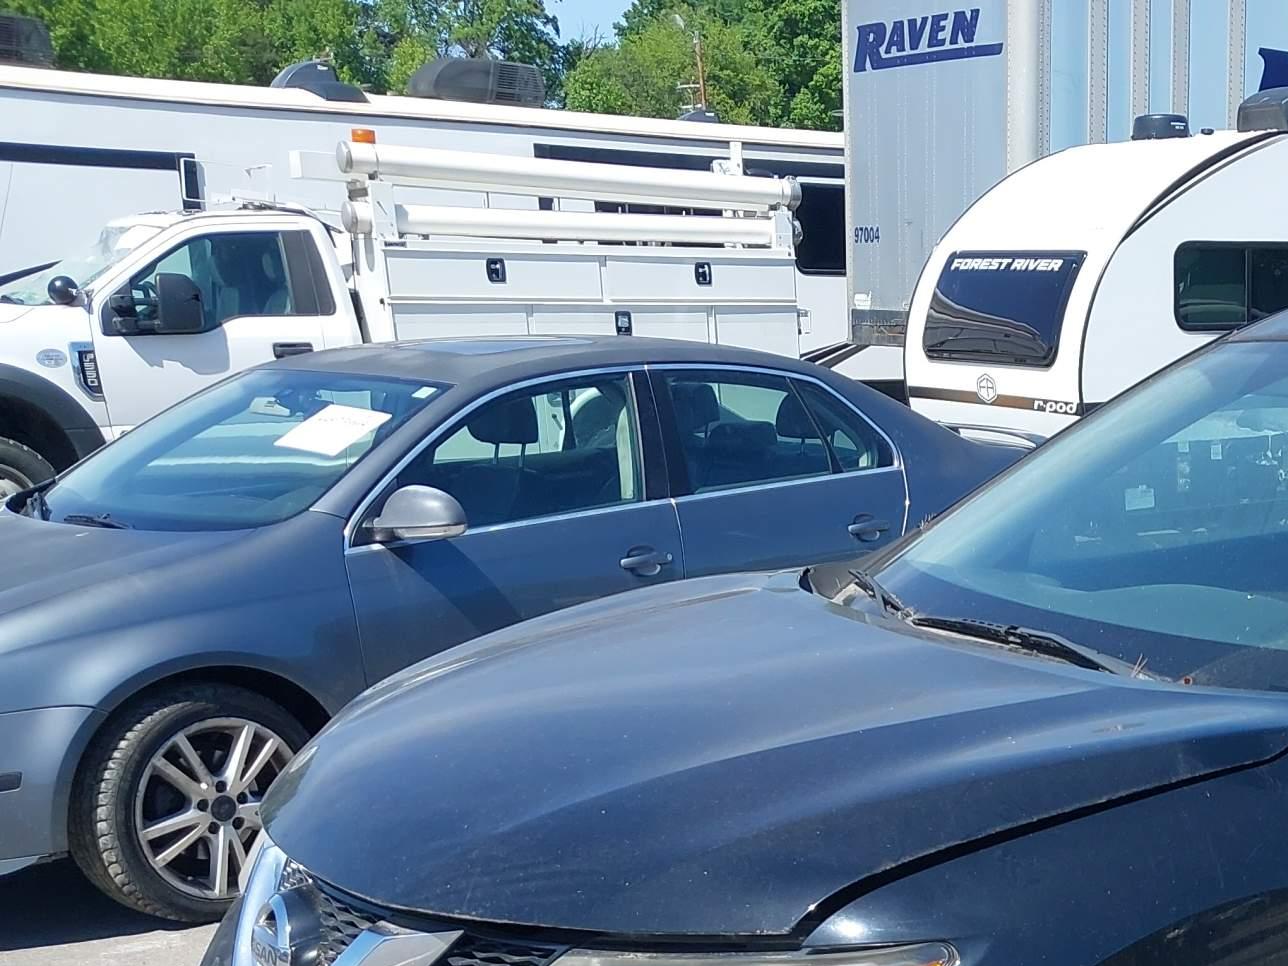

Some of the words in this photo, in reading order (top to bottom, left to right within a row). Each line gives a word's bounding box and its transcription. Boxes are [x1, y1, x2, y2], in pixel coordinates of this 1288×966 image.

[853, 9, 981, 73] RAVEN
[854, 226, 880, 244] 97004
[950, 258, 1013, 271] FOREST
[1010, 258, 1064, 272] RIVER
